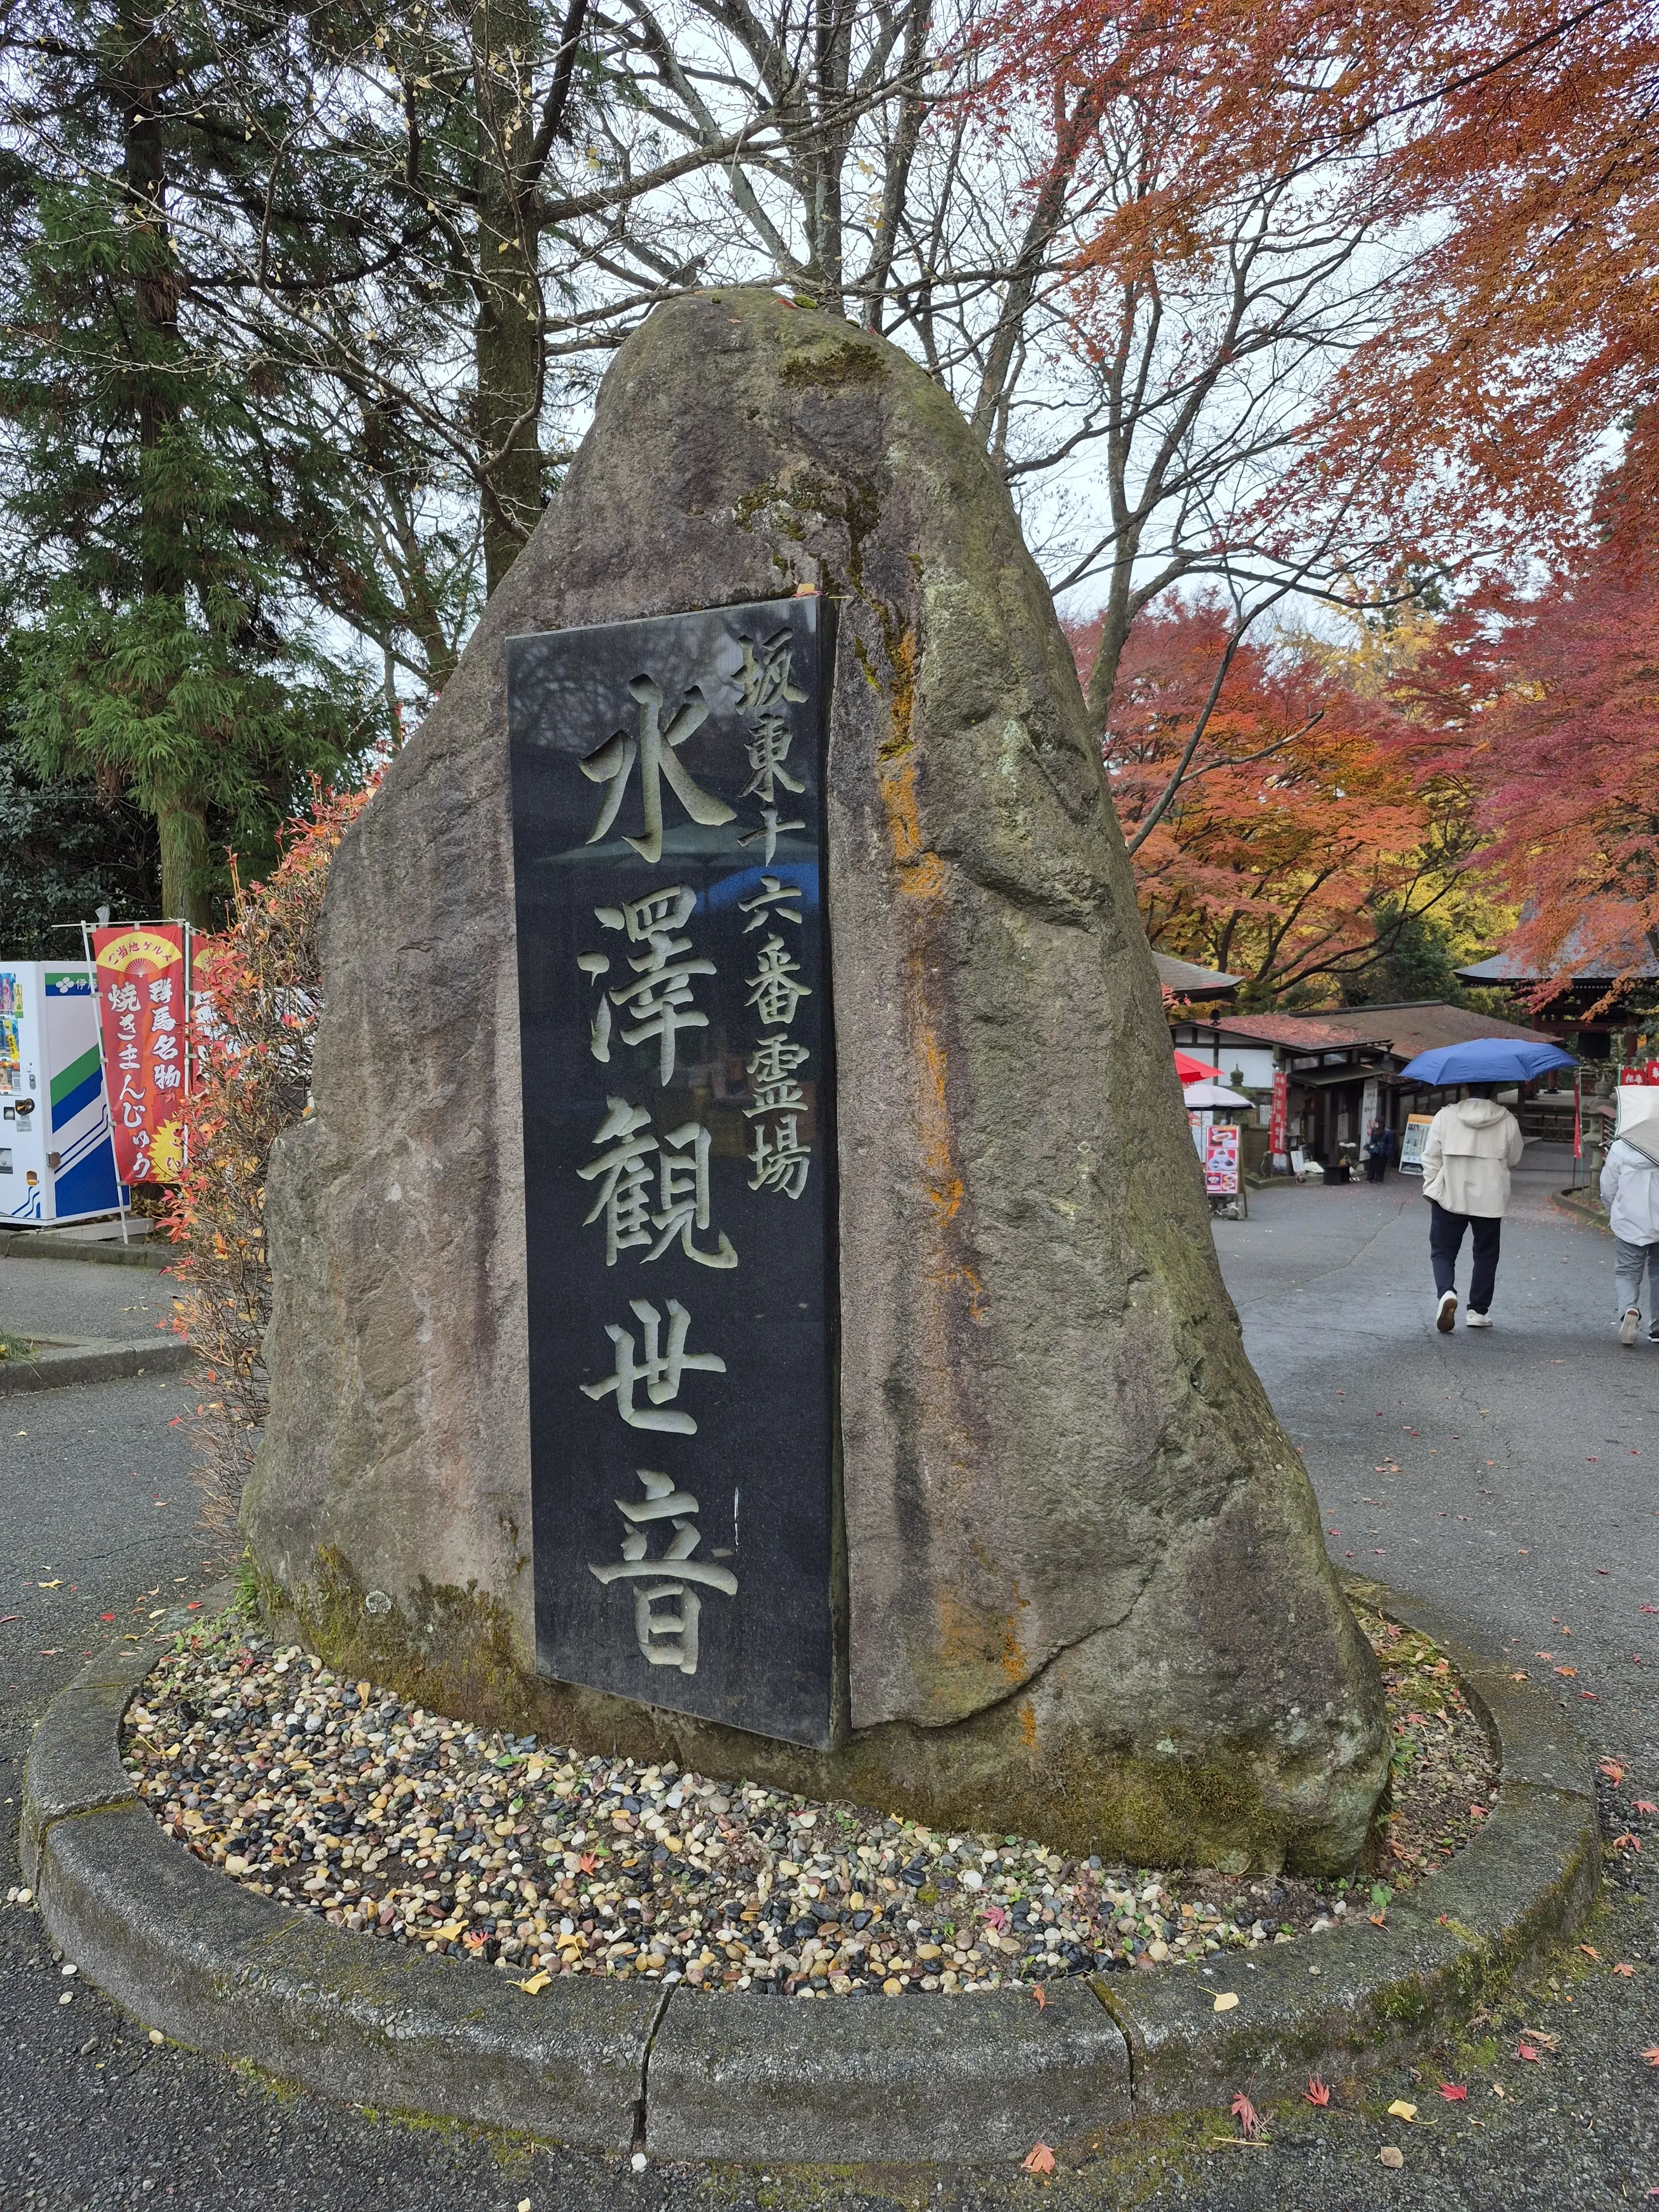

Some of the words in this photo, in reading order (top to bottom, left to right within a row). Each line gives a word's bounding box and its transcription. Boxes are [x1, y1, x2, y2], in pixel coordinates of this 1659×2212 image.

[107, 941, 172, 965] ご当地グルメ
[108, 982, 150, 1178] 焼きまんじゅう
[148, 978, 181, 1089] 群馬名物
